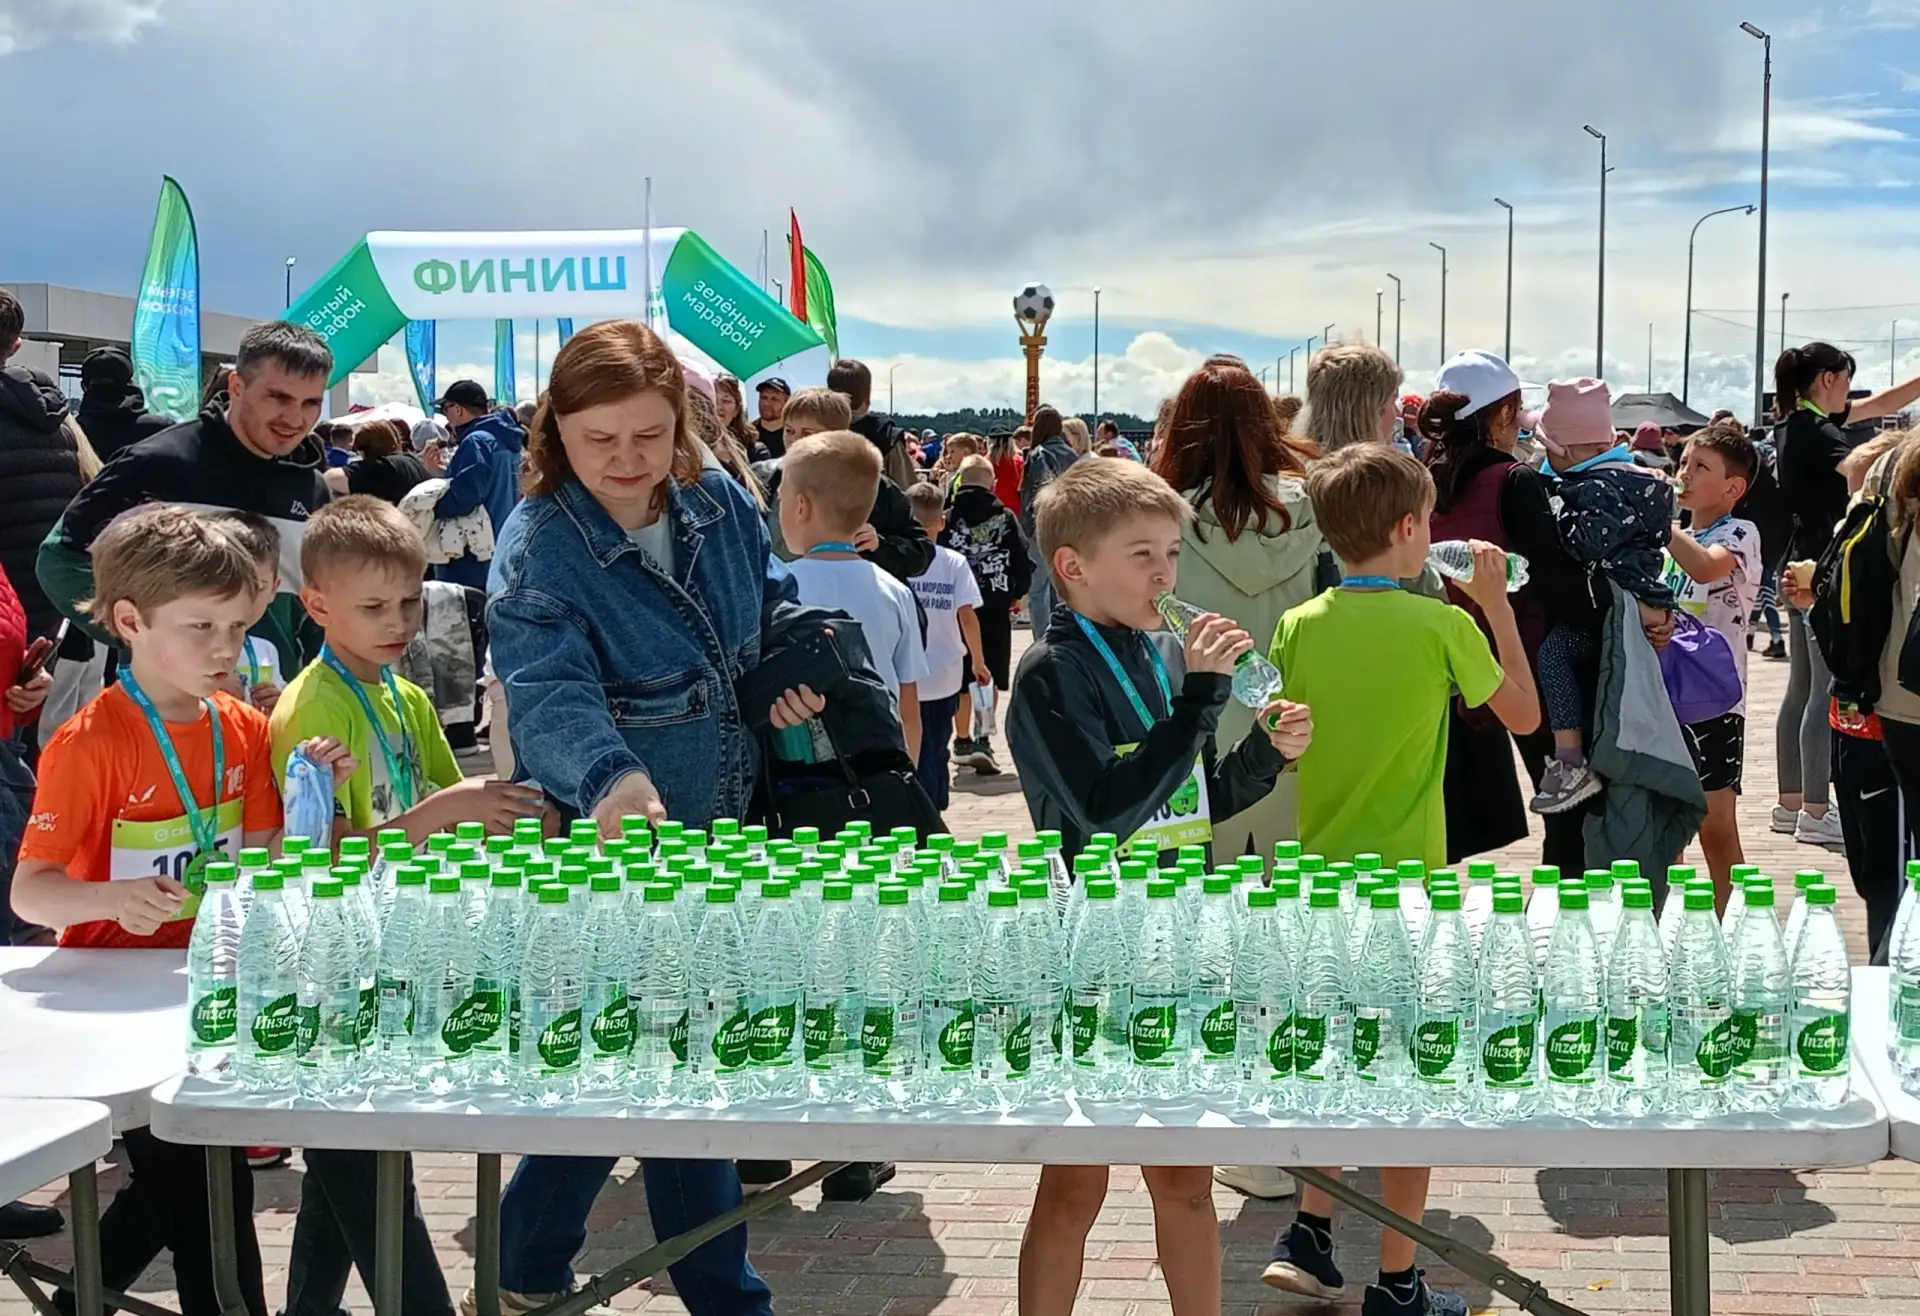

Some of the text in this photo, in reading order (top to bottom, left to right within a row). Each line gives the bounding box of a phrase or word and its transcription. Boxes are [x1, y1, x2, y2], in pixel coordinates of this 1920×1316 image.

[413, 256, 627, 294] ФИНИШ
[692, 279, 766, 340] зелёный
[682, 291, 753, 351] марафон
[253, 1015, 295, 1030] Инзер
[444, 1016, 474, 1032] Инзе
[474, 1011, 499, 1026] зера
[593, 1016, 629, 1030] Инзе
[1203, 1018, 1235, 1032] Инзе
[541, 1030, 580, 1045] Инзер
[720, 1029, 749, 1045] Inze
[749, 1023, 790, 1038] Inzera
[945, 1028, 973, 1043] Inze
[1550, 1037, 1592, 1055] Inzera
[1699, 1039, 1731, 1055] Инзе
[1803, 1032, 1844, 1049] Inzera
[1484, 1041, 1531, 1061] Инзера
